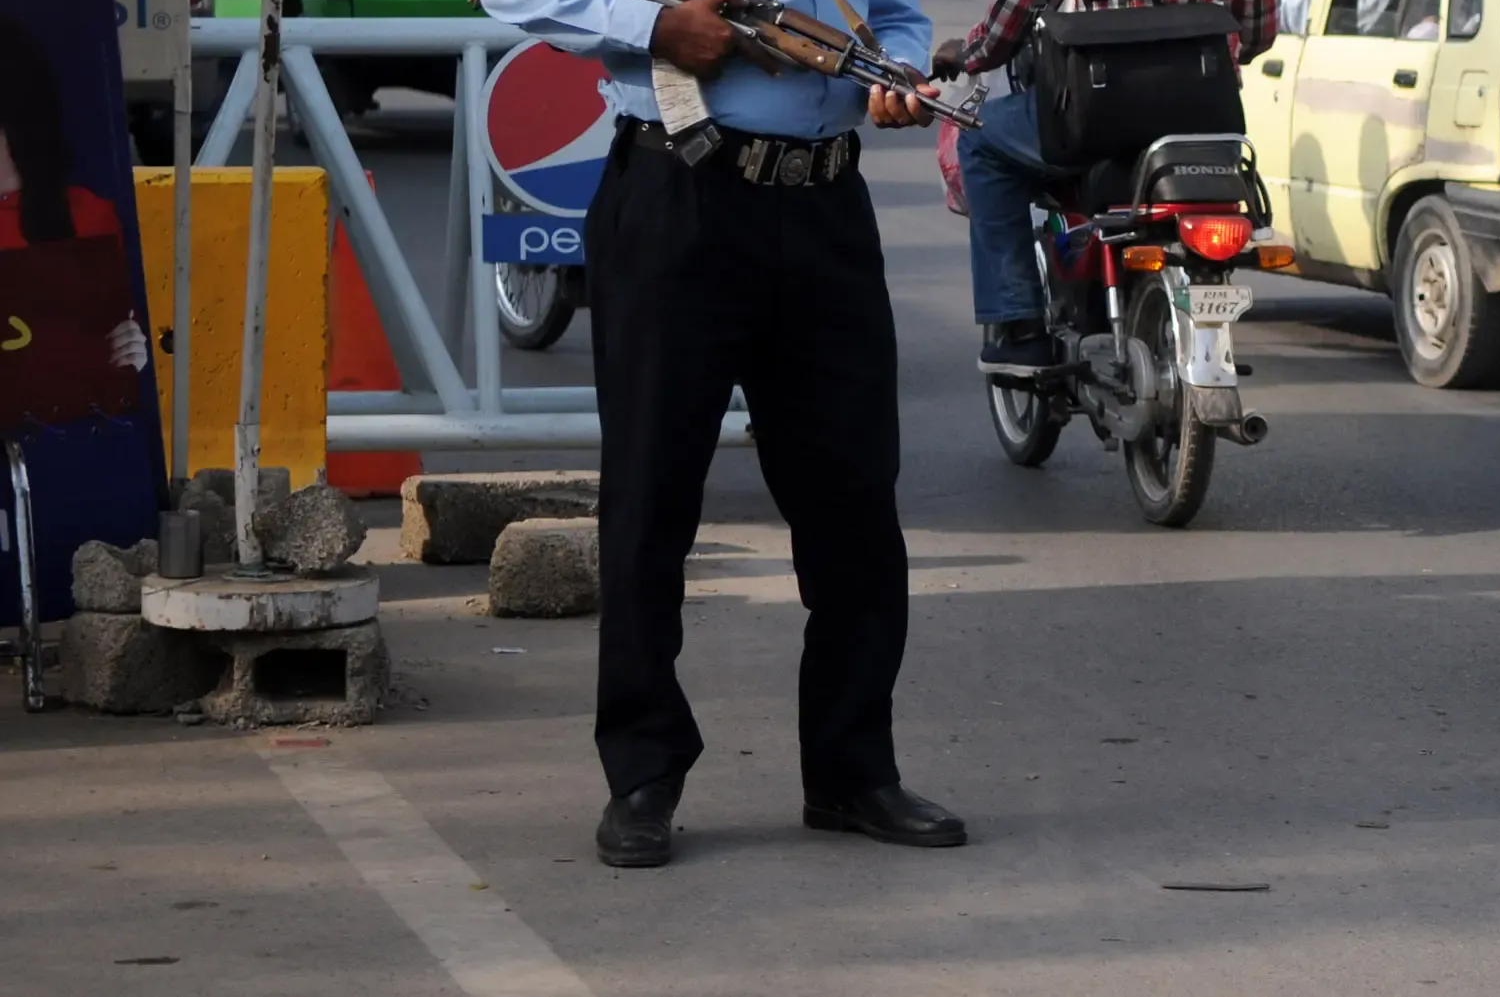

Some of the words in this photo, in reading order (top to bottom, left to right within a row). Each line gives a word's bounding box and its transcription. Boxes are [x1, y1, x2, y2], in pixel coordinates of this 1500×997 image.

[1173, 164, 1239, 176] HONDA
[520, 226, 585, 261] pe
[1192, 301, 1239, 315] 3167
